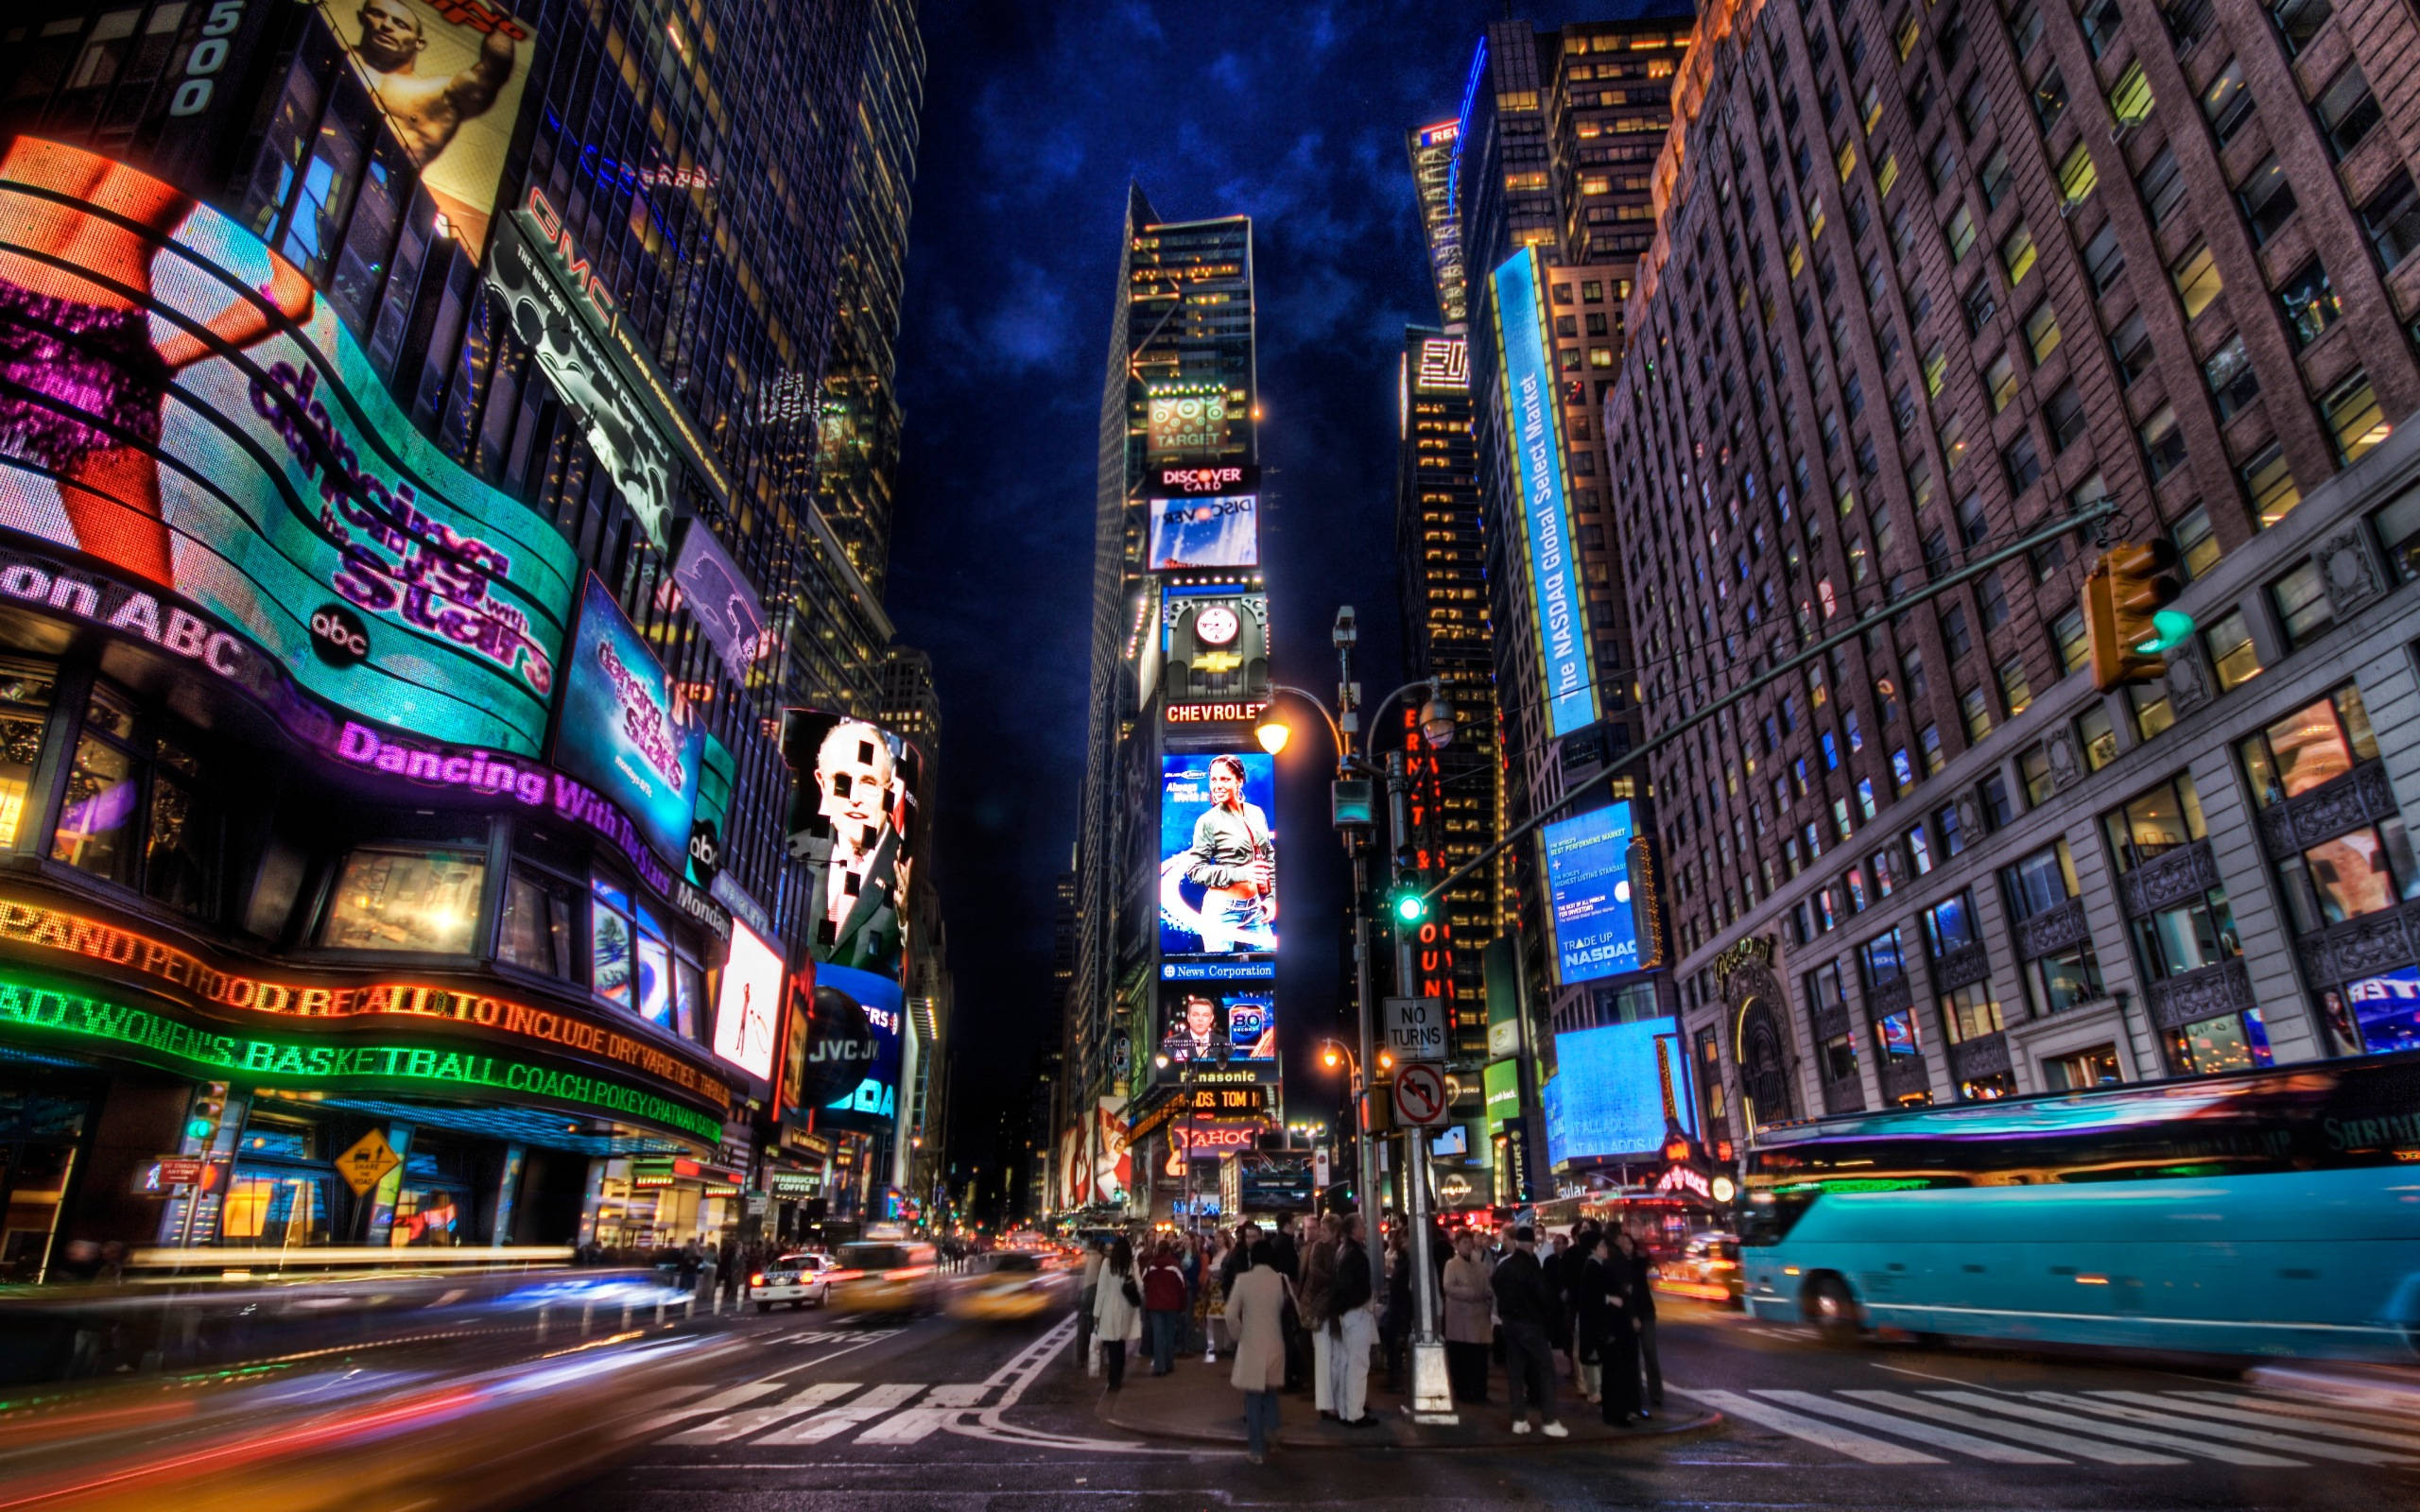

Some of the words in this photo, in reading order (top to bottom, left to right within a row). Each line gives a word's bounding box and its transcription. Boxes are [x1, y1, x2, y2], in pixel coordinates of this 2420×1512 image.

[169, 1, 245, 116] 500
[529, 187, 613, 326] GMC
[517, 244, 533, 268] THE
[532, 266, 550, 293] NEW
[548, 289, 567, 317] 2007
[617, 328, 633, 354] WE
[568, 315, 619, 391] YUKON
[619, 389, 669, 462] DENALI
[1524, 372, 1544, 437] Market
[1156, 433, 1220, 447] TARGET
[250, 361, 511, 605] dancing
[1164, 468, 1241, 485] DISCOVER
[1184, 481, 1221, 492] CARD
[1533, 439, 1552, 505] Select
[1539, 507, 1562, 580] Global
[0, 565, 98, 617] on
[108, 592, 243, 679] ABC
[311, 612, 368, 657] abc
[484, 594, 530, 634] with
[1546, 569, 1575, 656] NASDAQ
[598, 642, 662, 735] dancing
[1561, 661, 1580, 705] The
[339, 721, 546, 806] Dancing
[554, 774, 616, 838] With
[1602, 828, 1625, 841] MARKET
[677, 882, 731, 942] Mondays
[1564, 936, 1598, 951] TRADE
[1599, 931, 1614, 943] UP
[1178, 966, 1204, 977] News
[1209, 965, 1270, 978] Corporation
[144, 943, 195, 988] PET
[301, 984, 441, 1018] RECALL
[448, 991, 499, 1026] TO
[505, 1003, 606, 1055] INCLUDE
[608, 1033, 642, 1066] DRY
[642, 1043, 696, 1089] VARIETIES
[1233, 1014, 1260, 1028] 80
[1392, 1027, 1441, 1045] TURNS
[1401, 1007, 1426, 1023] NO
[83, 997, 236, 1068] WOMEN'S
[244, 1040, 495, 1087] BASKETBALL
[507, 1062, 591, 1103] COACH
[595, 1080, 648, 1116] POKEY
[809, 1040, 858, 1062] JVC
[1180, 1070, 1256, 1083] Pnasonic
[1221, 1091, 1247, 1108] TOM
[354, 1162, 378, 1171] SHARE
[778, 1183, 811, 1192] COFFEE
